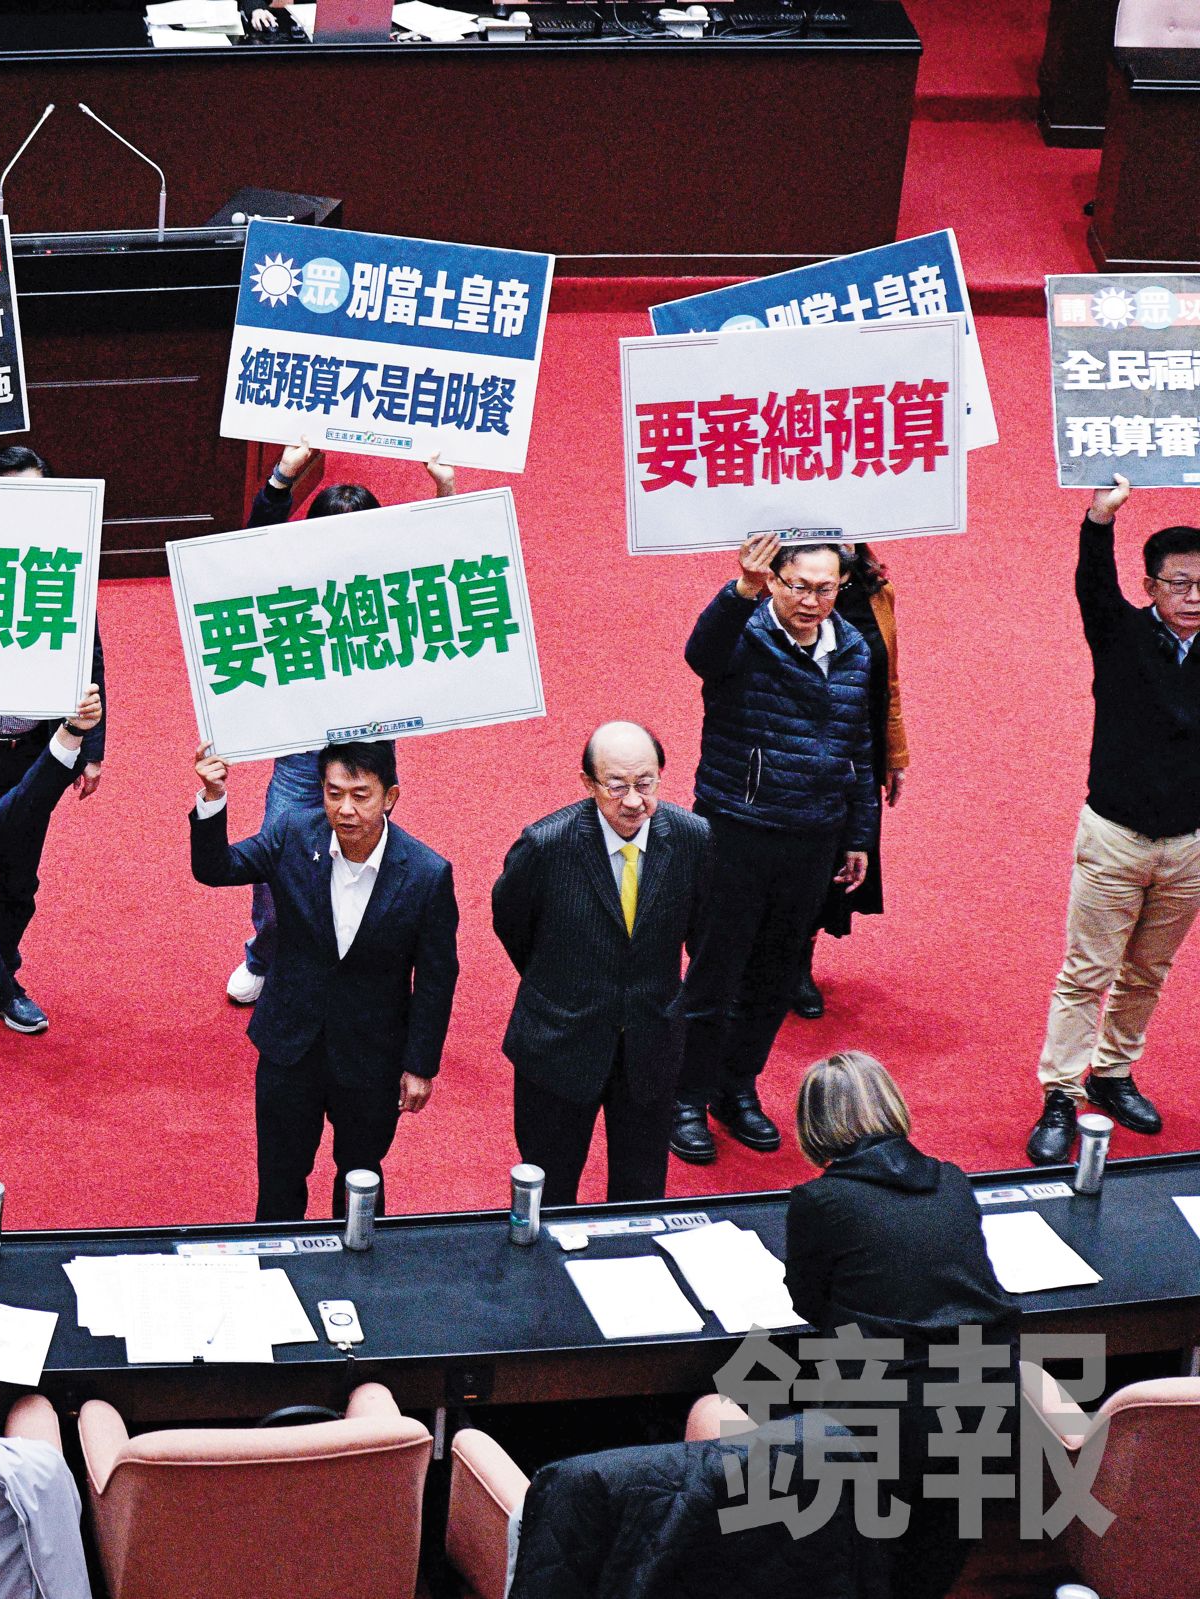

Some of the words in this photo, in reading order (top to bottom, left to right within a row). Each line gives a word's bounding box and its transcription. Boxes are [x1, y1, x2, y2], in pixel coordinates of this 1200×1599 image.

[346, 262, 531, 338] 別當土皇帝
[235, 346, 517, 436] 總預算不是自助餐
[1061, 350, 1200, 391] 全民福
[635, 379, 950, 493] 要審總預算
[193, 554, 520, 695] 要審總預算
[302, 1237, 338, 1249] 005
[670, 1215, 708, 1228] 006
